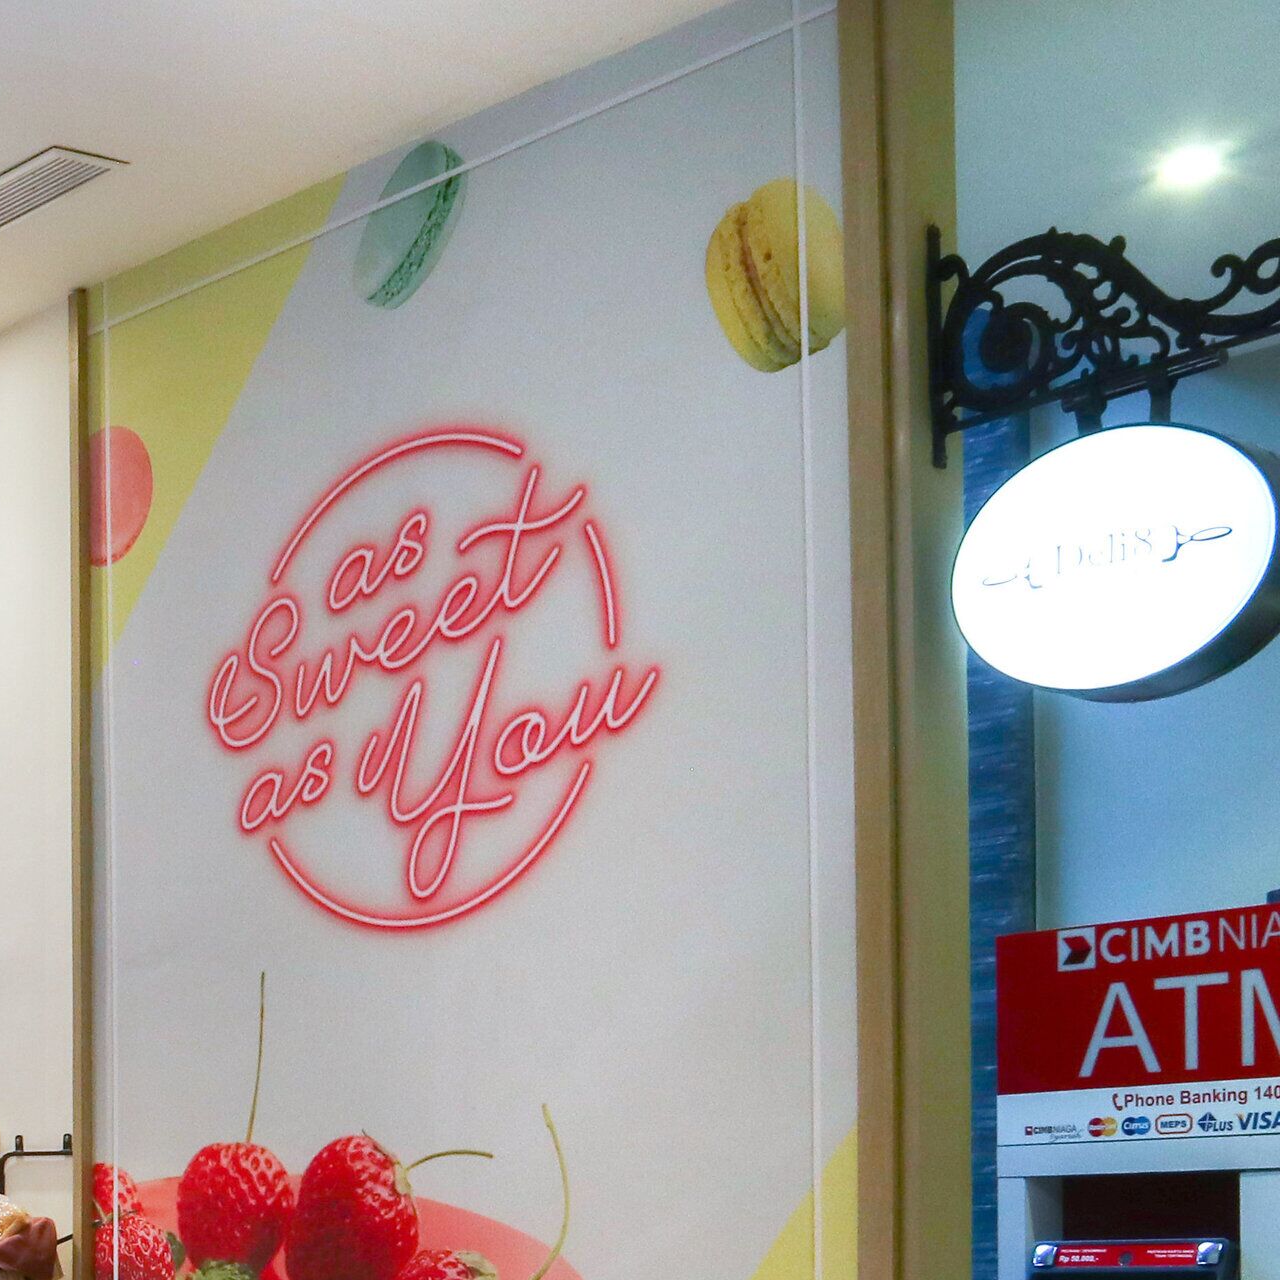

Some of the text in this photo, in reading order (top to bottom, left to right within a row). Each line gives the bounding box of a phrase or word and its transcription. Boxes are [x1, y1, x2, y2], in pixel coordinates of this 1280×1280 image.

[208, 466, 586, 748] Sweet
[327, 511, 429, 610] as
[240, 637, 659, 898] as You
[1124, 1093, 1175, 1108] Phone
[1180, 1088, 1248, 1105] Banking
[1160, 1120, 1187, 1129] MEPS
[1207, 1120, 1233, 1132] PLUS
